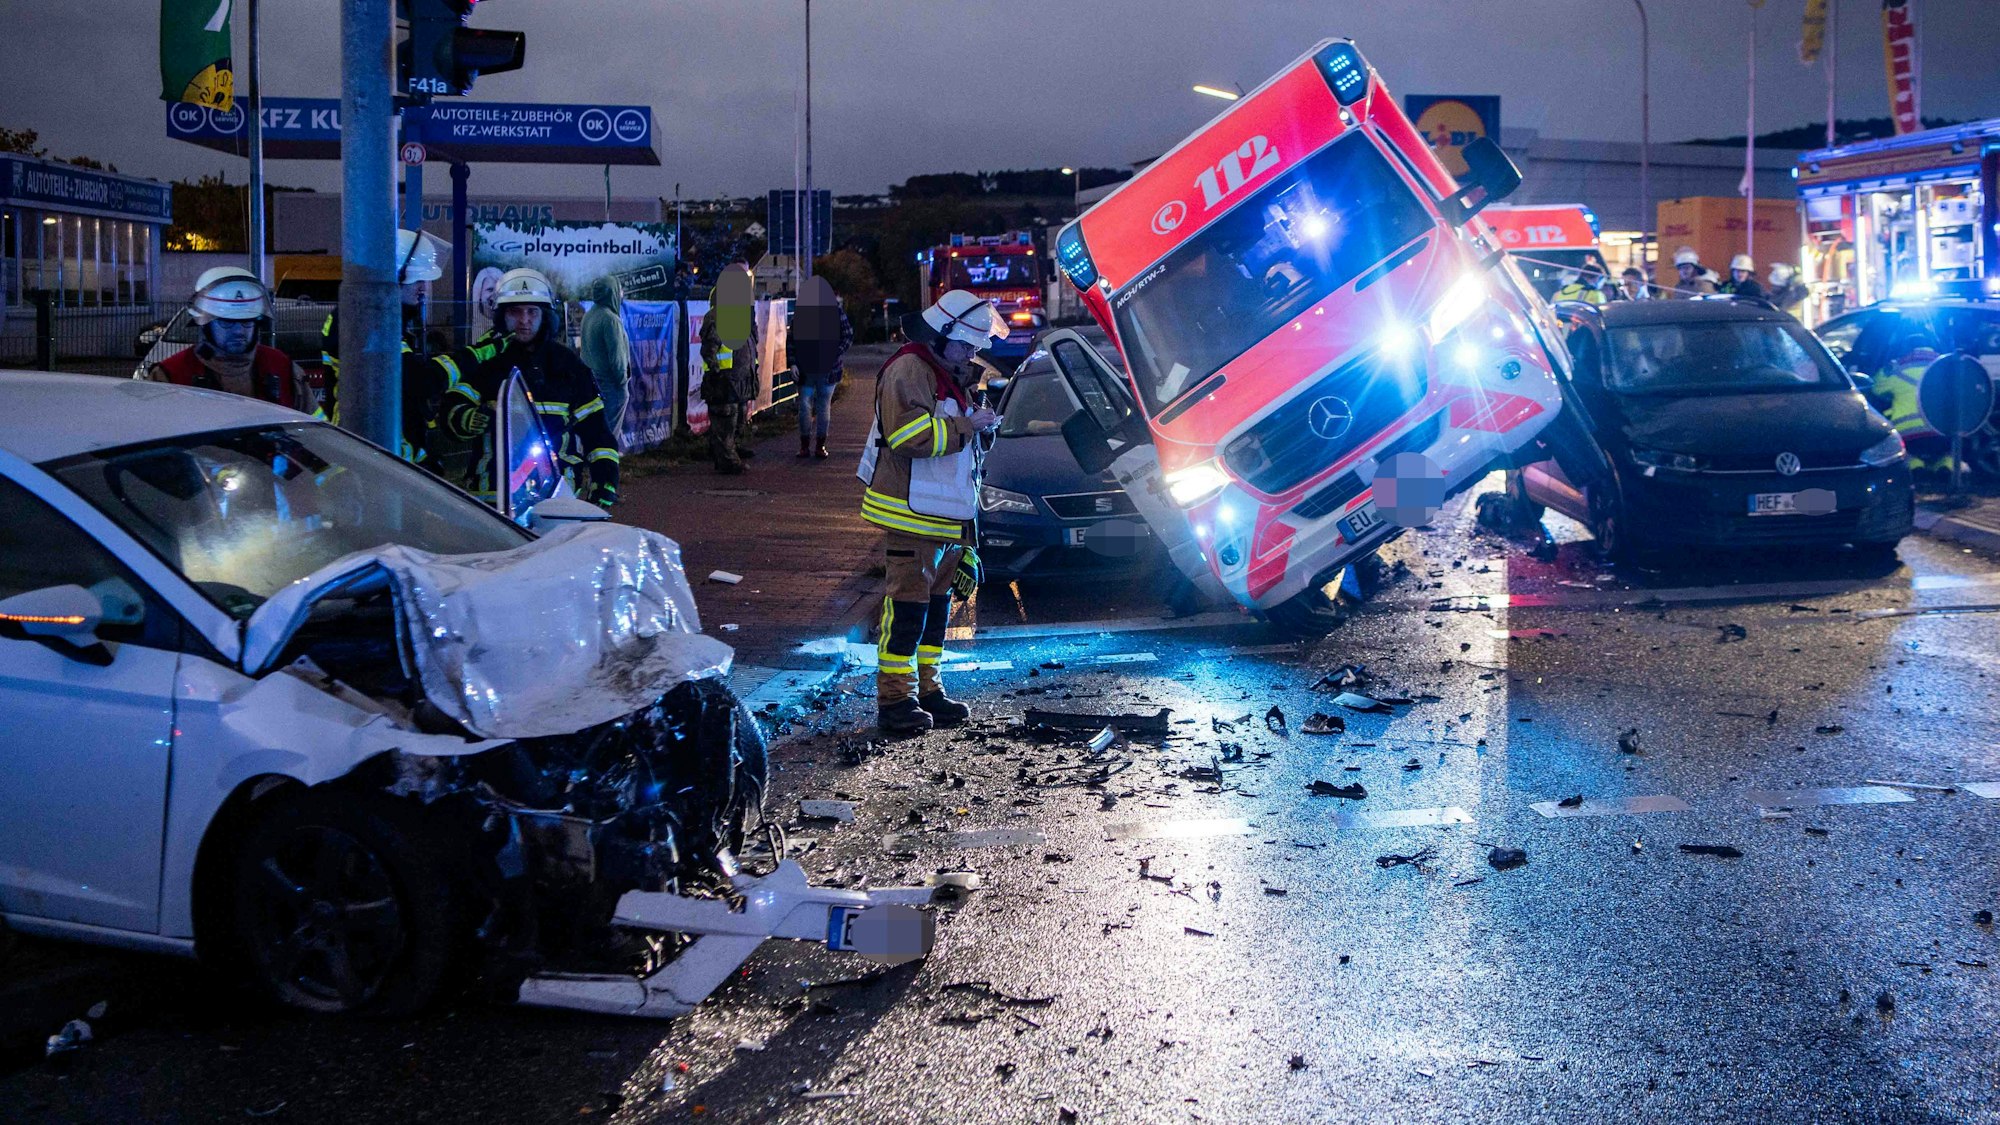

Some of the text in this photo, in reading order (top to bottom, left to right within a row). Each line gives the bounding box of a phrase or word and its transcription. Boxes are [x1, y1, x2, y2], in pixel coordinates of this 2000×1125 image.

[408, 78, 447, 94] F41a
[178, 109, 198, 122] OK
[431, 108, 573, 123] AUTOTEILE+ZUBEHÖR
[453, 124, 552, 138] KFZ-WERKSTATT
[586, 119, 604, 130] OK
[1193, 134, 1281, 212] 112
[27, 169, 109, 204] AUTOTEILE+ZUBEHÖR
[1524, 225, 1567, 244] 112
[524, 237, 659, 256] playpaintball.de
[521, 280, 528, 291] A
[1116, 264, 1167, 309] MCH/RTW-2
[234, 290, 244, 300] A
[1757, 494, 1783, 510] HEF
[1347, 510, 1373, 534] EU
